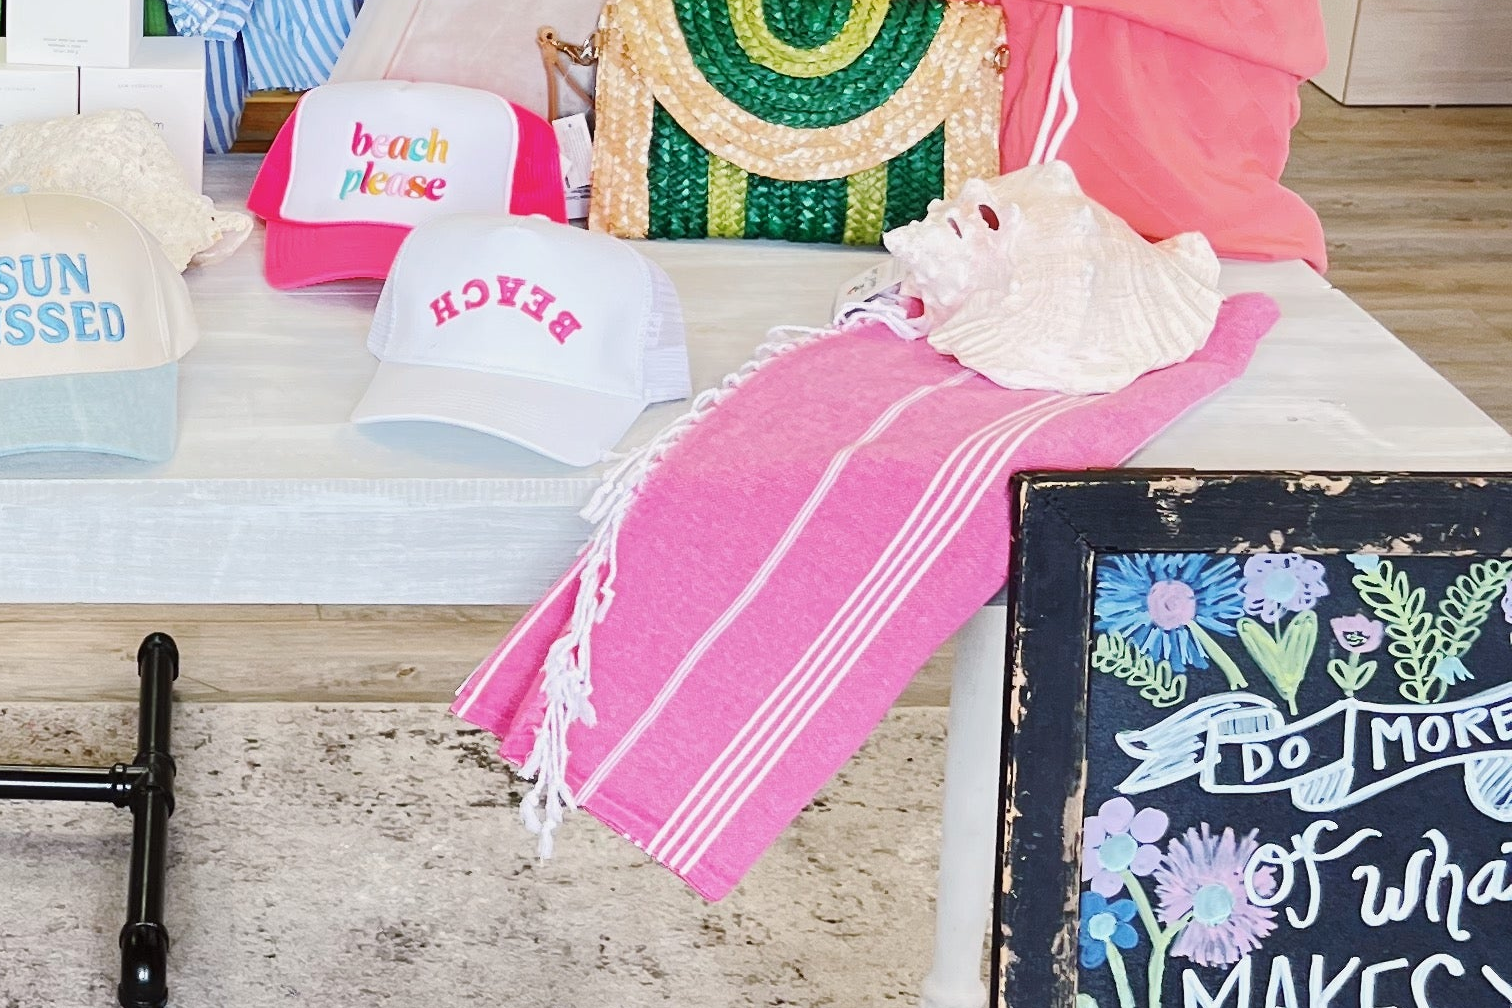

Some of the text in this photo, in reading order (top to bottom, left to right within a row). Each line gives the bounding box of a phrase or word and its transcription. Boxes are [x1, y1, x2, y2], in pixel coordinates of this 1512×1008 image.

[351, 121, 449, 164] beach
[339, 160, 447, 201] please
[429, 275, 582, 345] BEACH
[1241, 701, 1512, 783] DO MORE
[1351, 828, 1512, 942] wha
